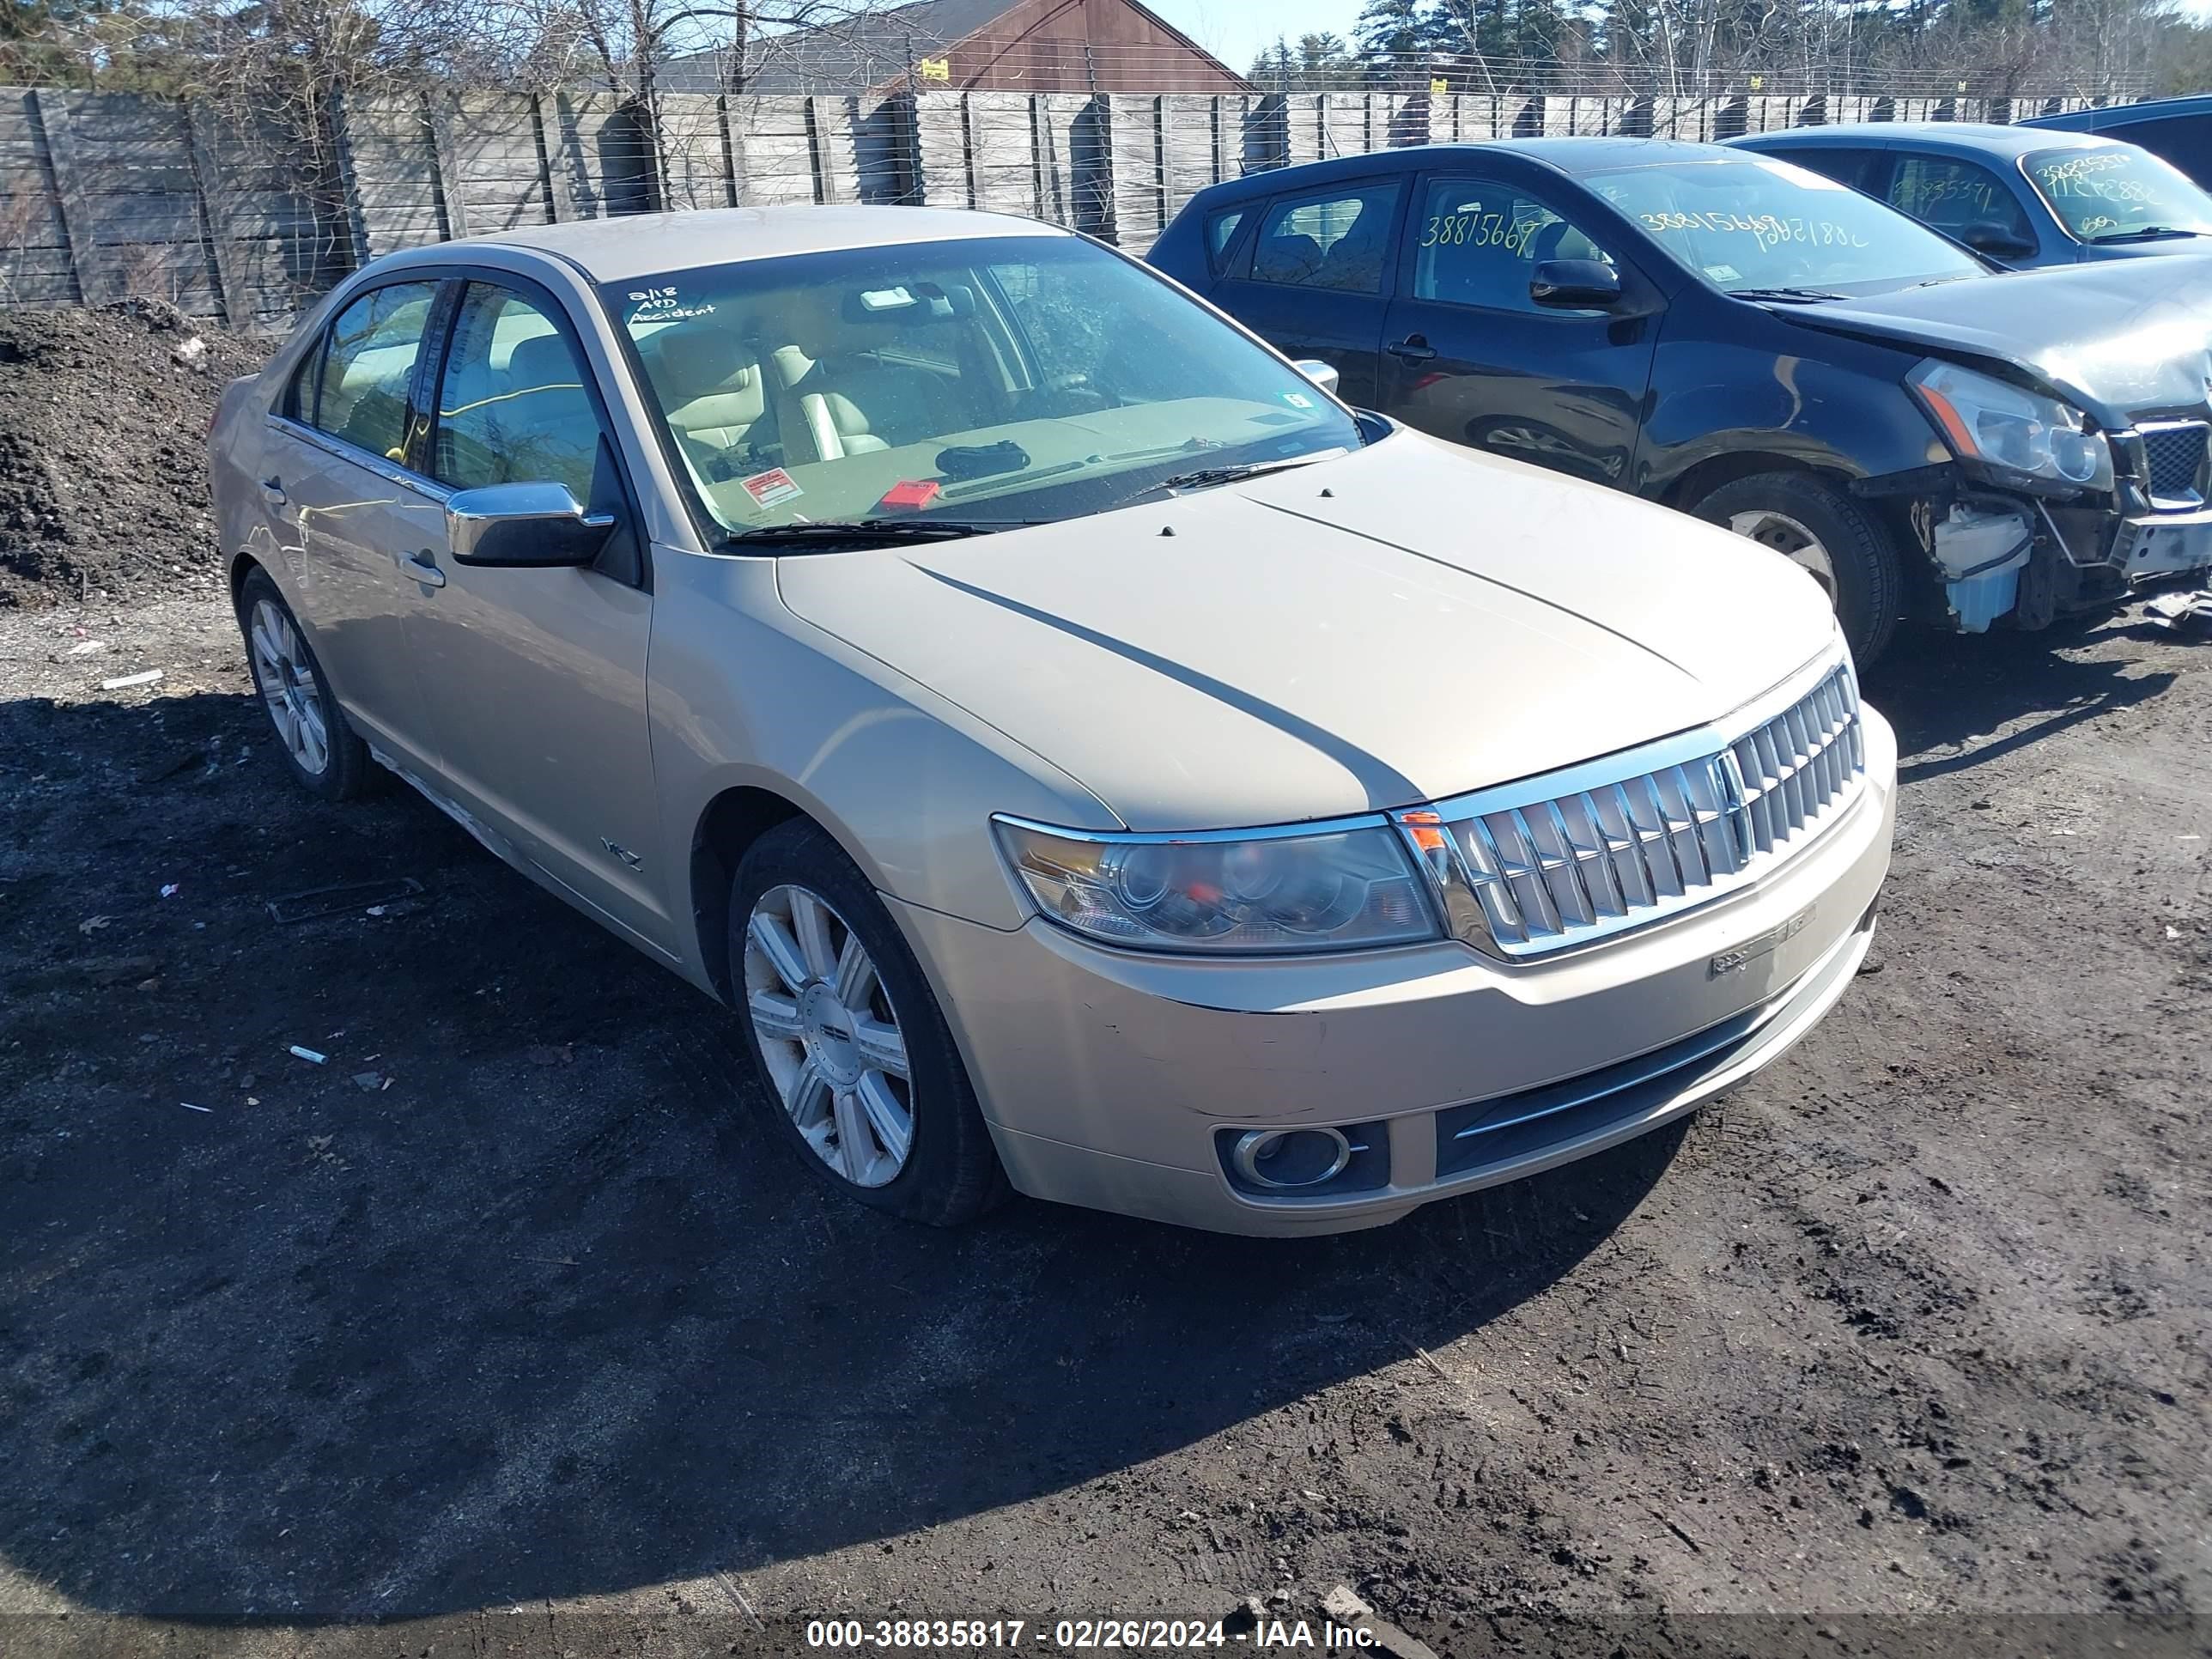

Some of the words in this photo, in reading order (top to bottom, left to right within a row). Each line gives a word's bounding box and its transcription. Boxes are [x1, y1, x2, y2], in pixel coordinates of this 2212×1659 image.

[1421, 214, 1535, 257] 38815669
[628, 287, 678, 301] 2/18
[637, 299, 678, 312] APD
[628, 305, 716, 325] Accident
